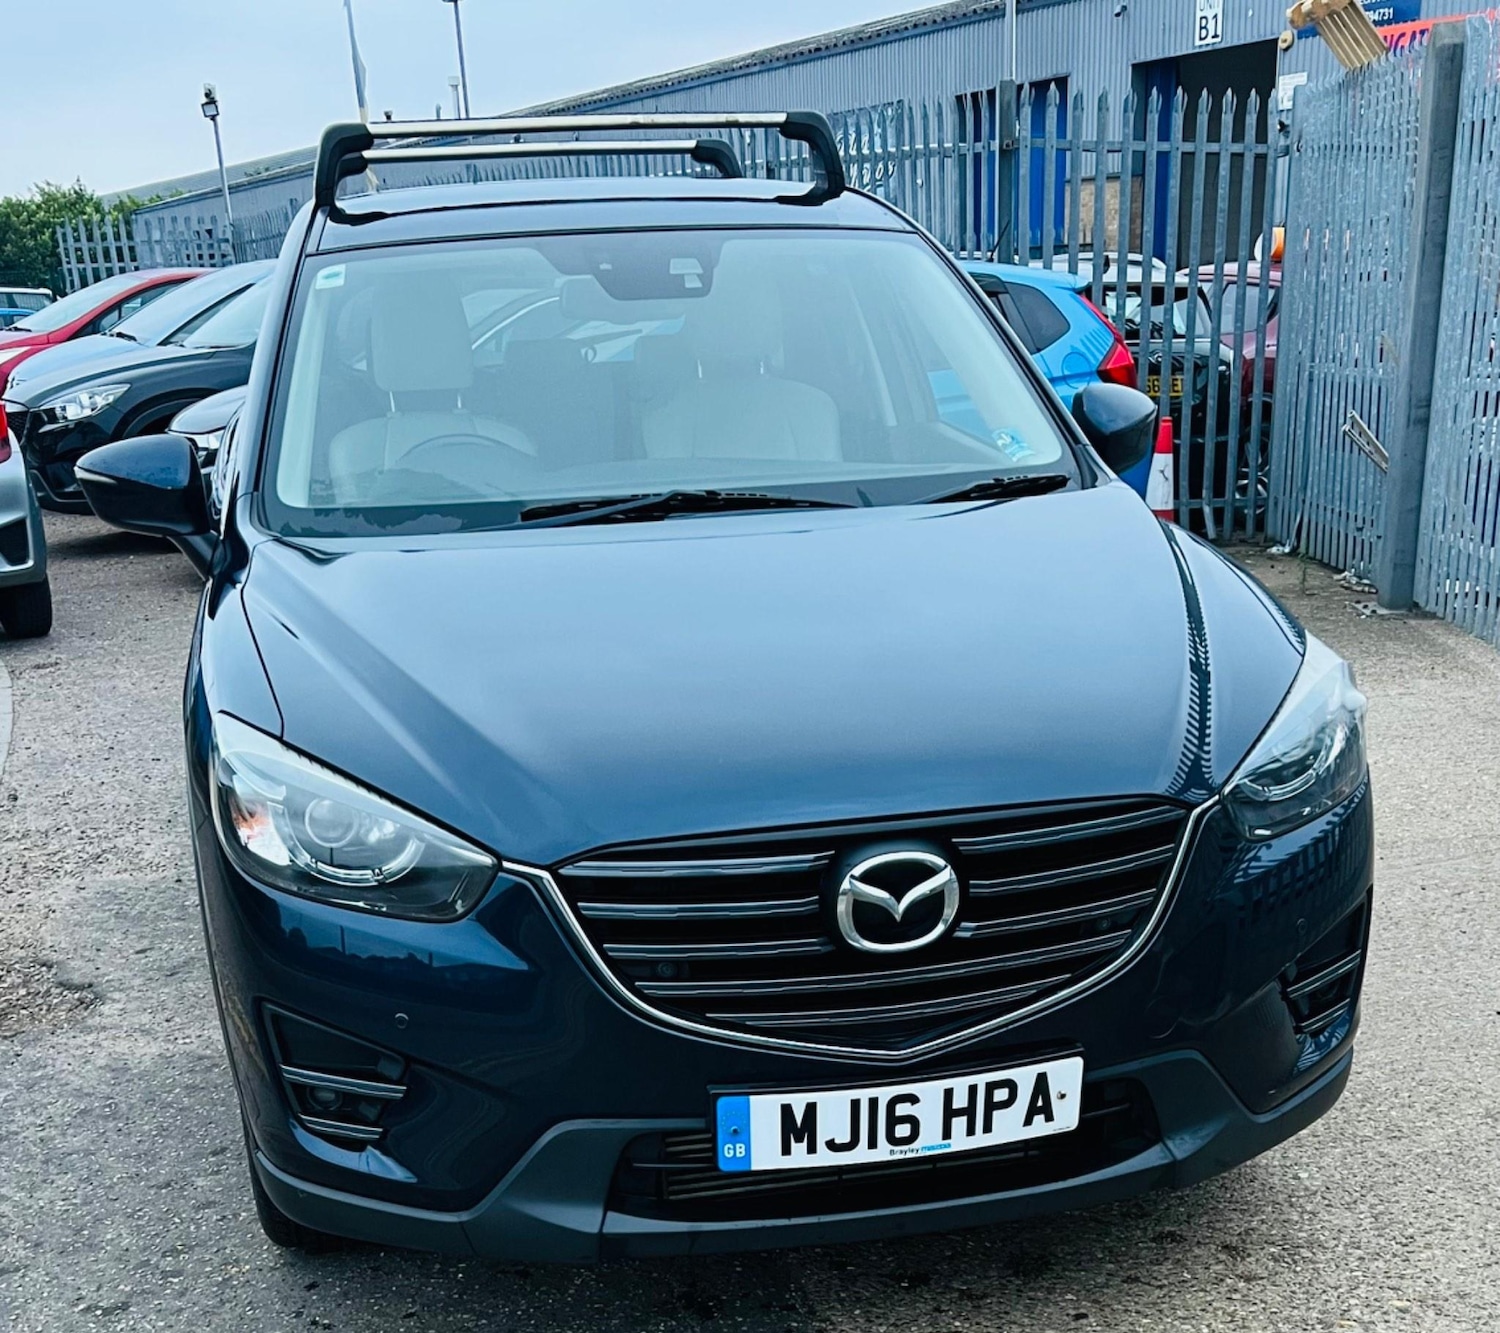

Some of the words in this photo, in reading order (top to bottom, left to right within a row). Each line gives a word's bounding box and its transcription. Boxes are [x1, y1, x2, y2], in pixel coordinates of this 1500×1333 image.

[1199, 13, 1220, 41] B1
[780, 1092, 921, 1157] MJ16
[942, 1071, 1055, 1141] HPA
[723, 1143, 746, 1158] GB
